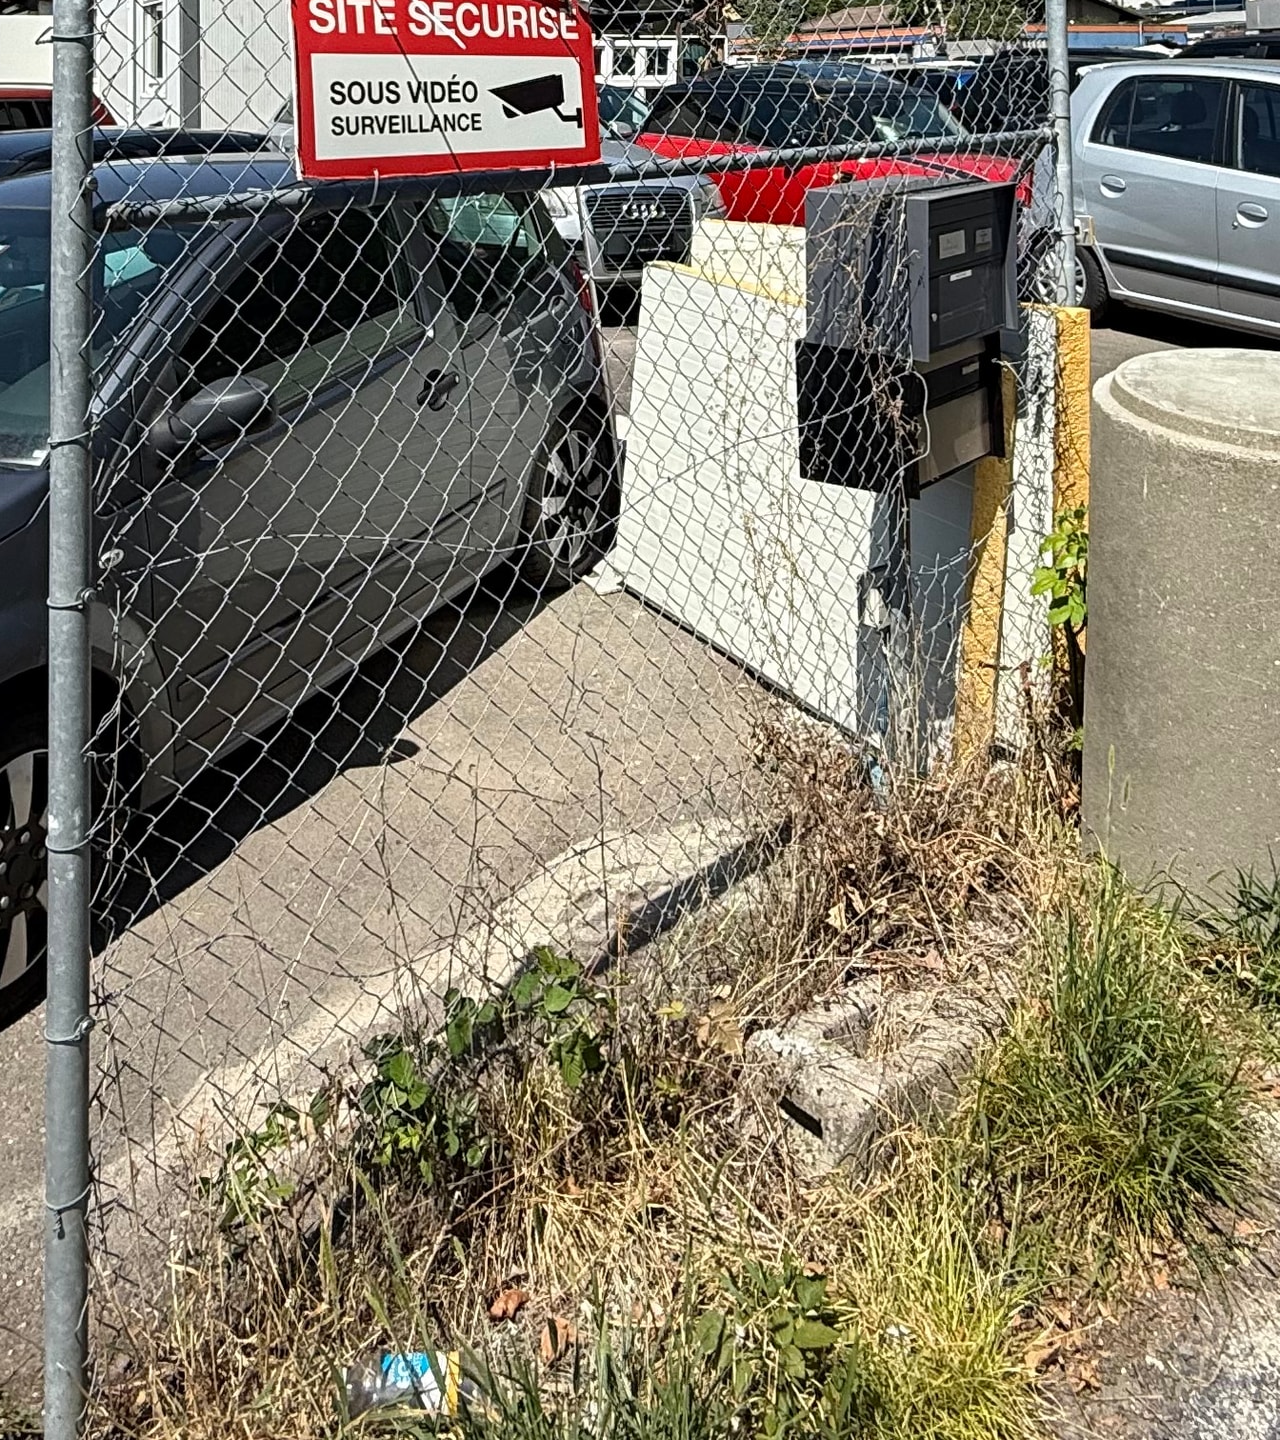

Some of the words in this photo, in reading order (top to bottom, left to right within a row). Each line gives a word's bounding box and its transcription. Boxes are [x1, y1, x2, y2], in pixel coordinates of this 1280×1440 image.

[329, 80, 402, 105] SOUS
[409, 74, 479, 104] VIDÉO
[330, 113, 483, 136] SURVEILLANCE
